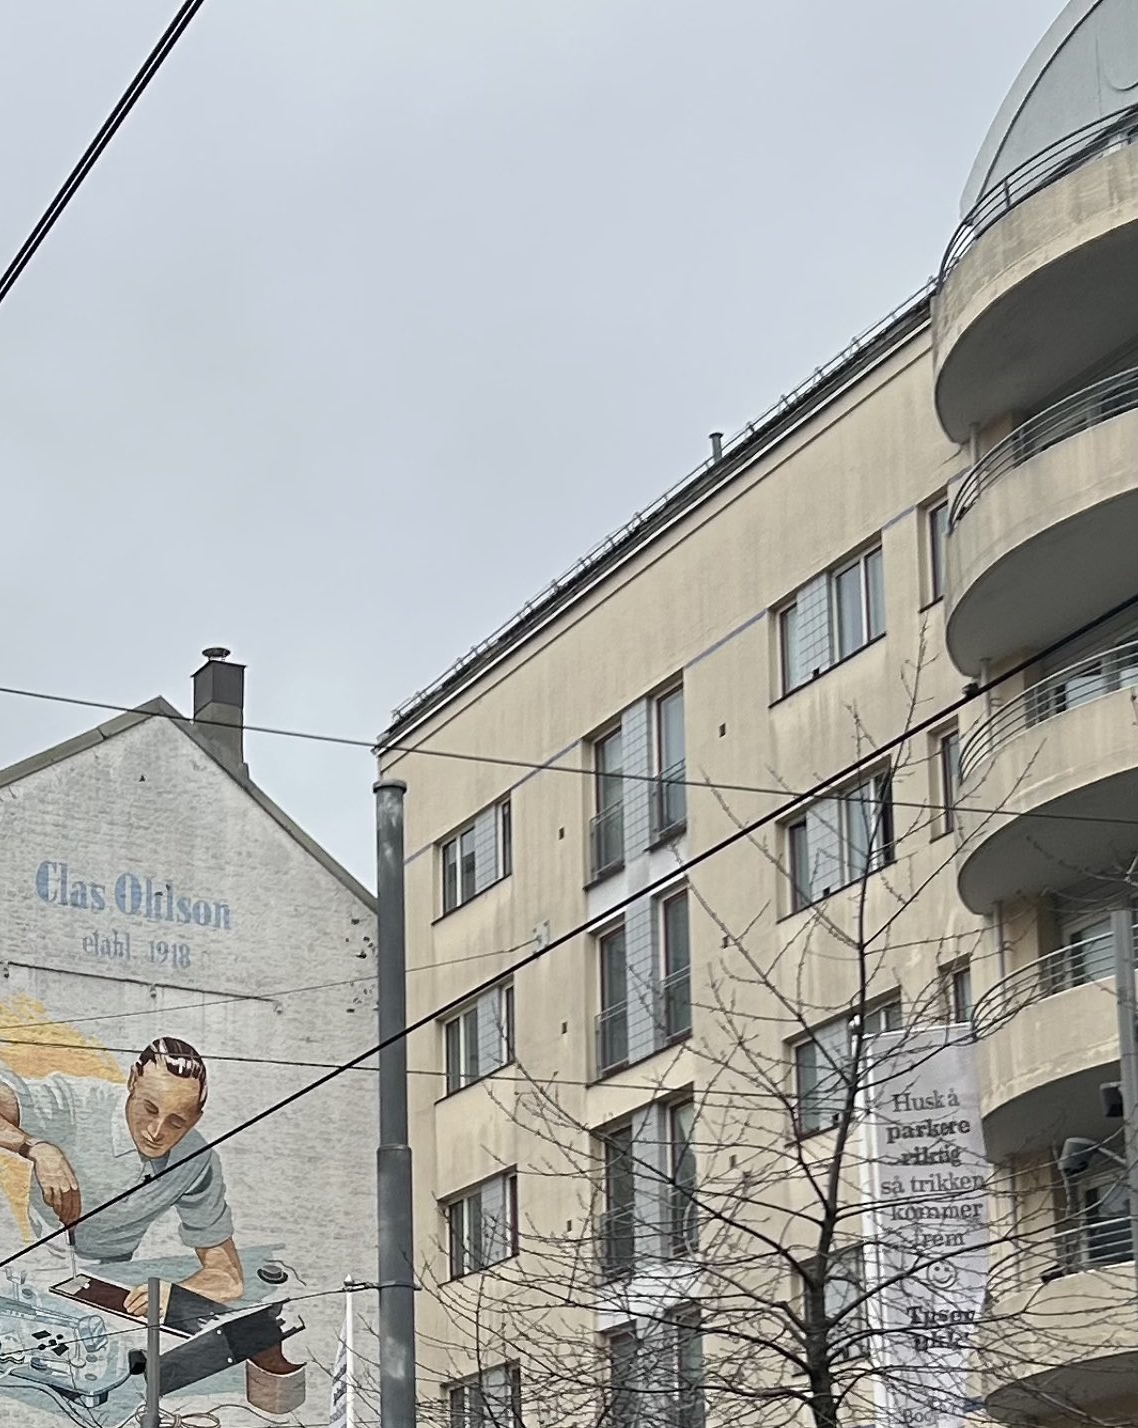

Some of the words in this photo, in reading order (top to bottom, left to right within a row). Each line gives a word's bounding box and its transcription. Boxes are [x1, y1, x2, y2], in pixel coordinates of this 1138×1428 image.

[35, 859, 106, 914] Clas
[114, 872, 231, 930] Ohlson
[149, 940, 191, 969] 1918
[892, 1089, 945, 1113] Husk
[947, 1088, 960, 1107] å
[886, 1118, 971, 1144] parkere
[880, 1175, 905, 1196] så
[910, 1171, 985, 1193] trikken
[890, 1202, 984, 1222] kommer
